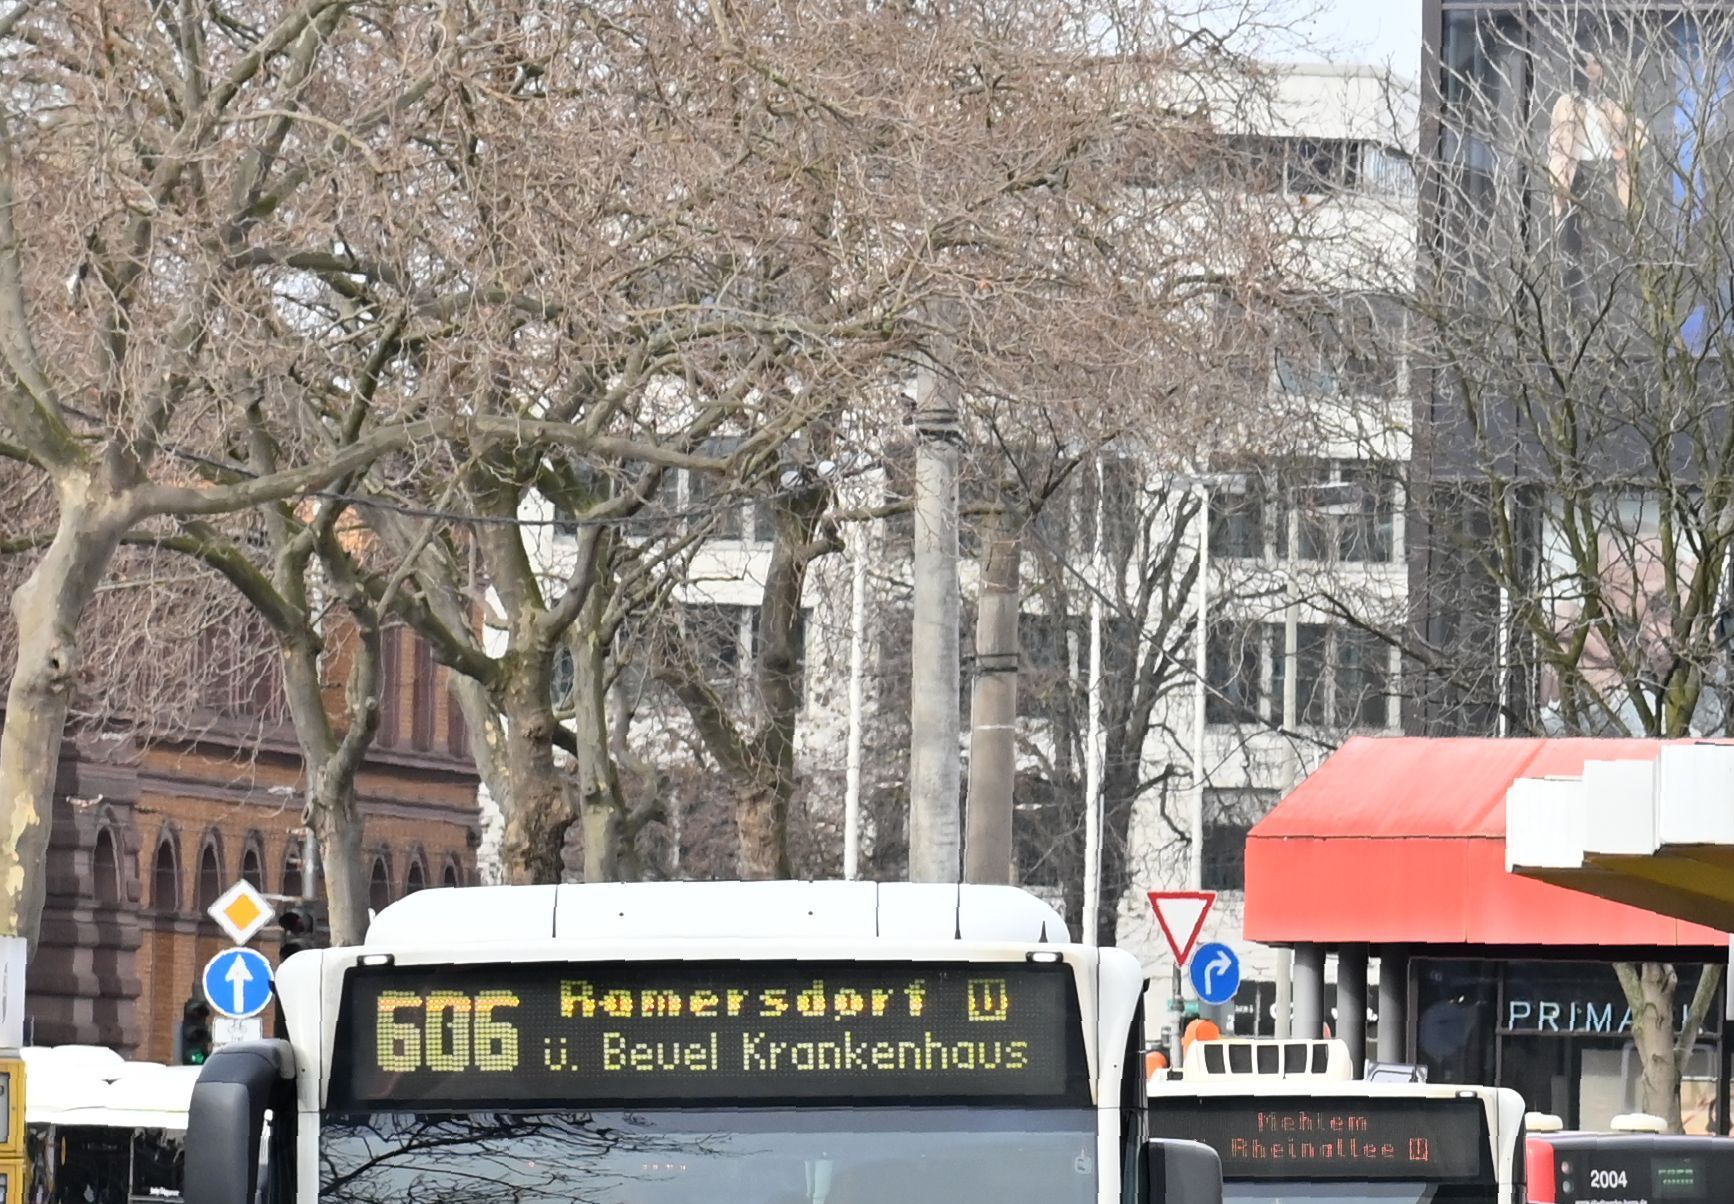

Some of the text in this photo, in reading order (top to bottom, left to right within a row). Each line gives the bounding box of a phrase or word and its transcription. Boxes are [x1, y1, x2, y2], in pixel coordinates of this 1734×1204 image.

[560, 979, 926, 1019] Ramersdorf
[377, 990, 520, 1072] 606
[1508, 1001, 1703, 1034] PRIMA
[544, 1031, 1028, 1071] ü. Beuel Krankenhaus
[1257, 1111, 1369, 1132] Mehlem
[1230, 1137, 1395, 1159] Rheinallee
[1590, 1168, 1628, 1189] 2004
